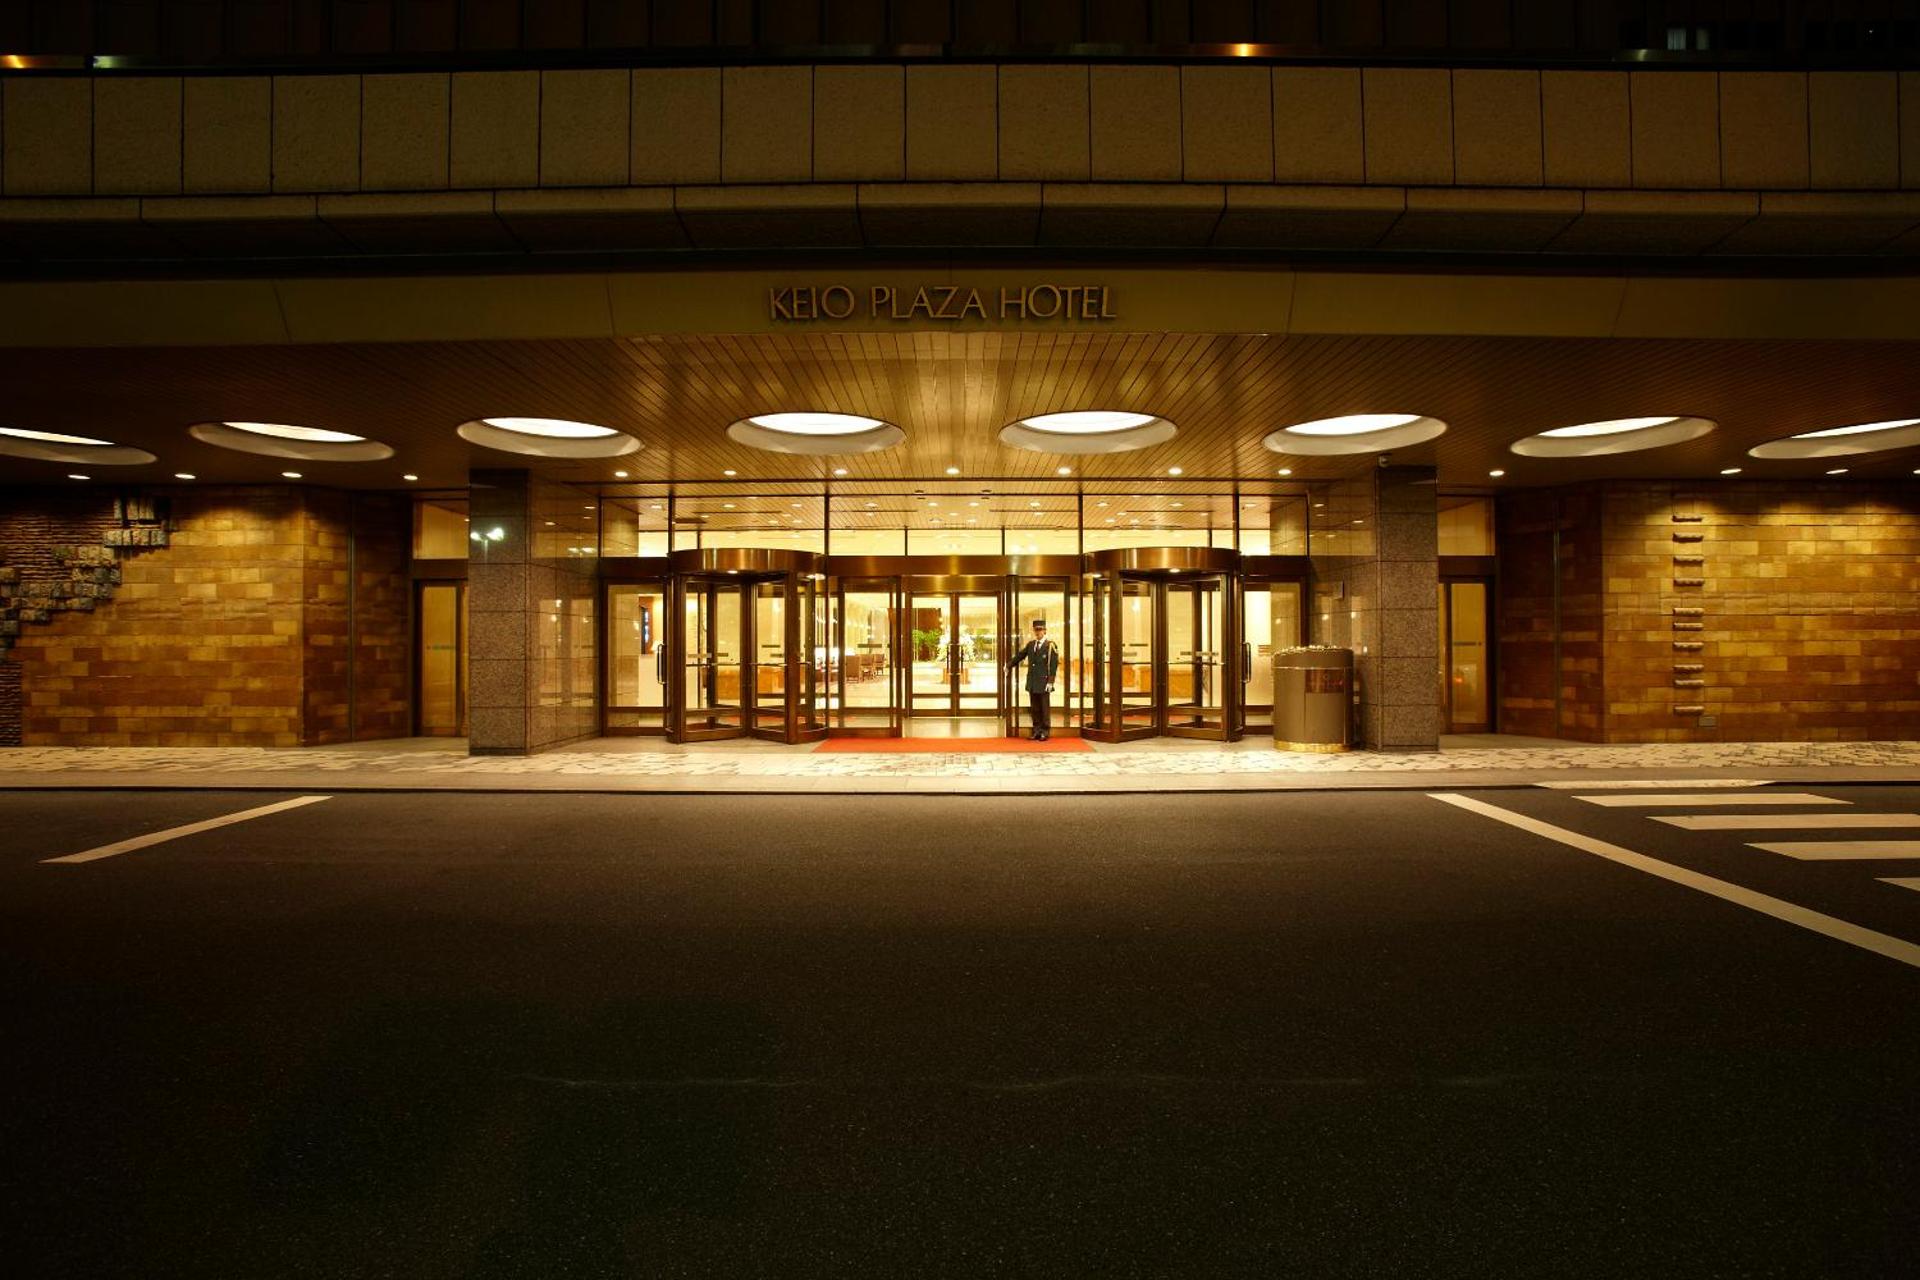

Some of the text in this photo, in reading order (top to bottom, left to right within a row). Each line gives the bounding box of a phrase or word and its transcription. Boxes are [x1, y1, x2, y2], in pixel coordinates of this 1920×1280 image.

[769, 284, 1117, 319] KEIO PLAZA HOTEL
